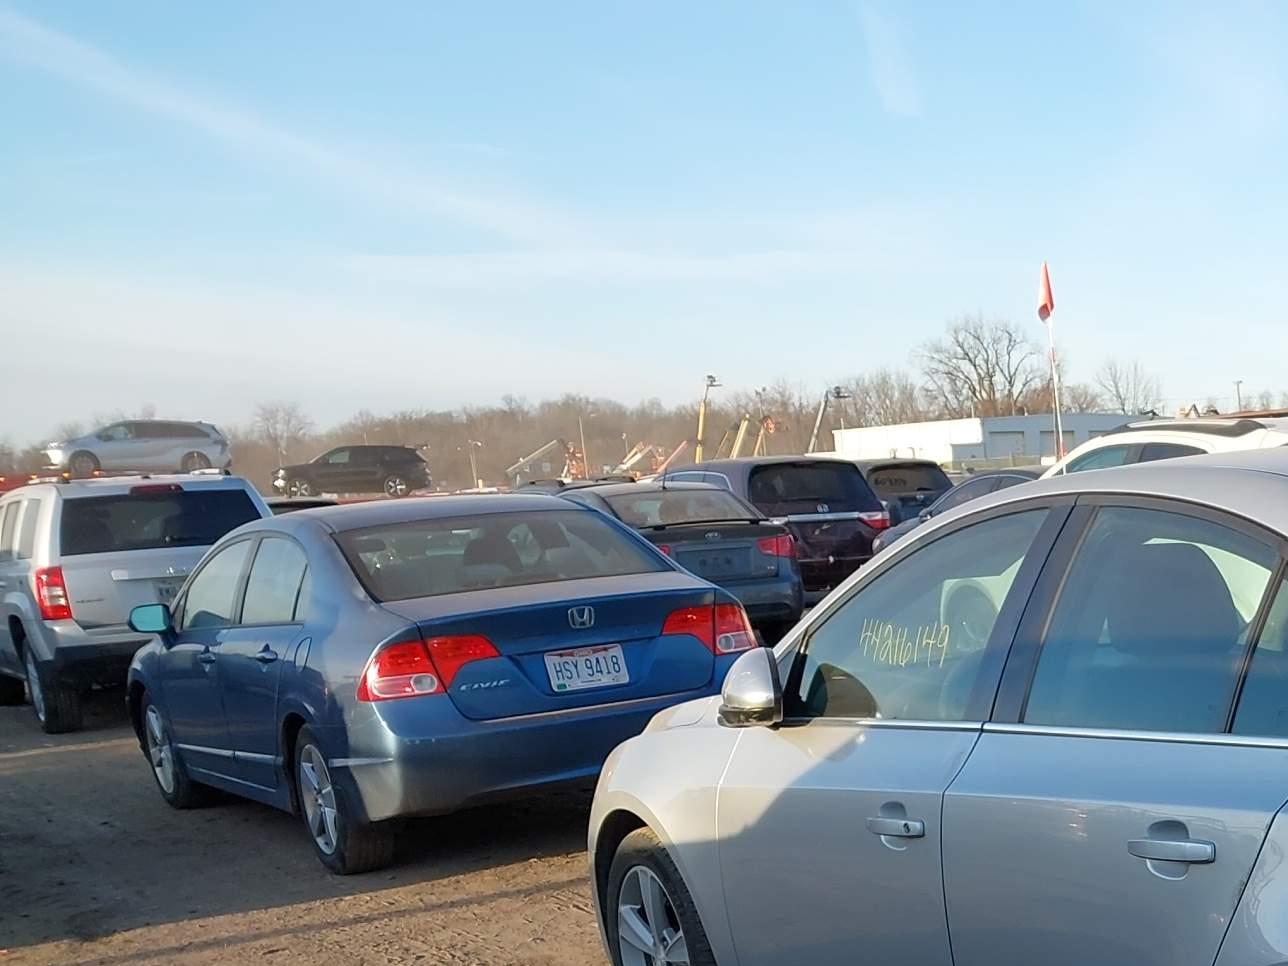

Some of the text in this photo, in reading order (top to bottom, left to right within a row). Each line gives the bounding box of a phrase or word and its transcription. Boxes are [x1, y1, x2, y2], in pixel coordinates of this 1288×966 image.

[860, 618, 949, 668] 44216149
[553, 655, 621, 681] HSY 9418
